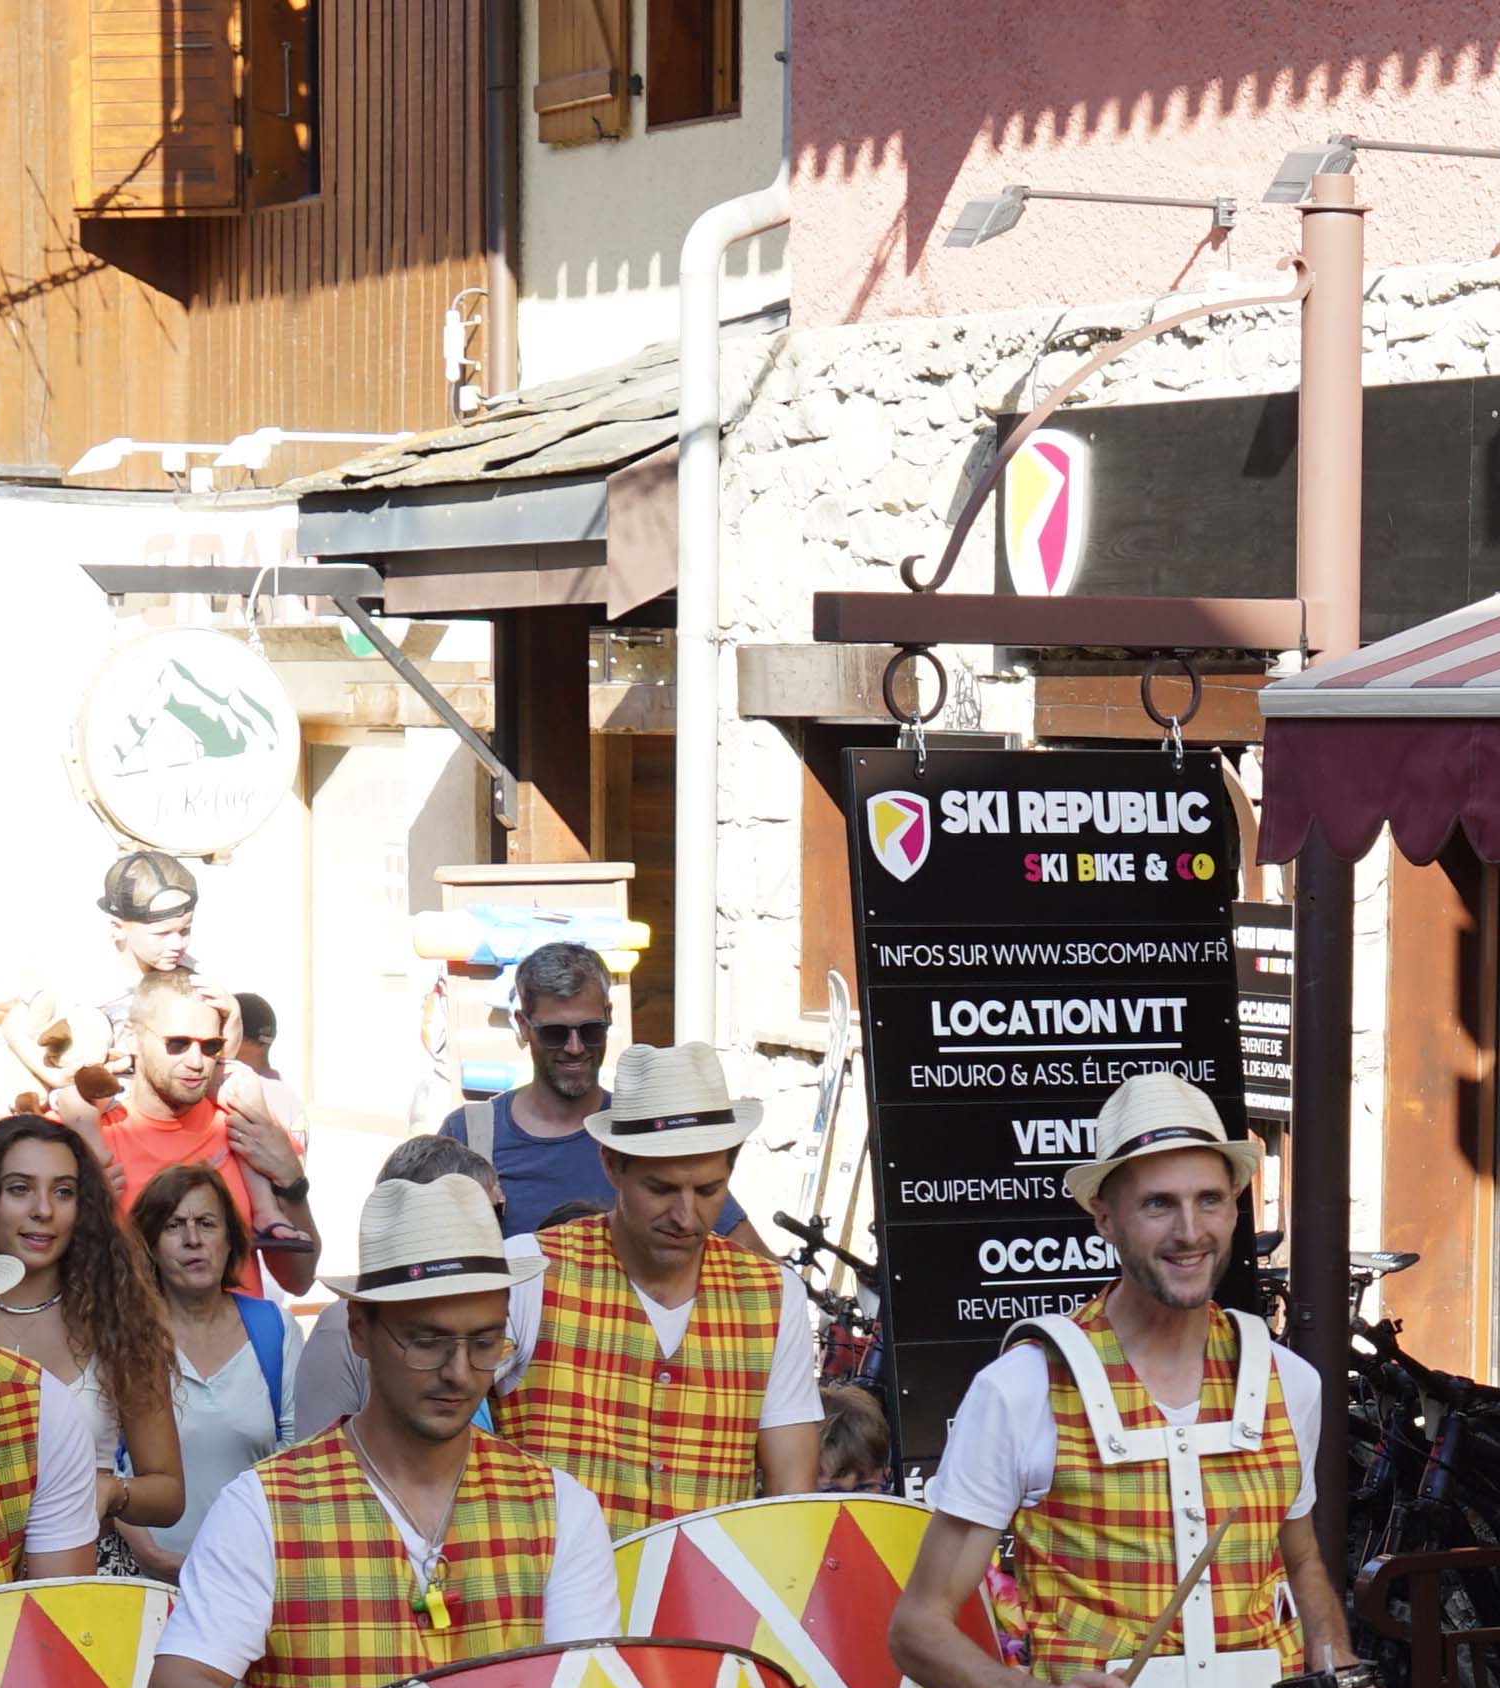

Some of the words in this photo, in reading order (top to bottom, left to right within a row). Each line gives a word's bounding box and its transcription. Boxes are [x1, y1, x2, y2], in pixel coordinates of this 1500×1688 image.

[940, 790, 1010, 836] SKI
[1020, 790, 1212, 836] REPUBLIC
[1025, 855, 1069, 883] SKI
[1078, 854, 1136, 883] BIKE
[1145, 856, 1169, 883] &
[879, 943, 946, 968] INFOS
[949, 943, 989, 967] SUR
[991, 940, 1229, 966] WWW.SBCOMPANY.FR
[931, 999, 1118, 1038] LOCATION
[1122, 998, 1188, 1035] VTT
[910, 1063, 1006, 1089] ENDURO
[1011, 1062, 1029, 1087] &
[1032, 1062, 1079, 1086] ASS.
[1011, 1118, 1099, 1155] VENT
[901, 1176, 1057, 1204] EQUIPEMENTS
[978, 1235, 1122, 1275] OCCASI
[957, 1296, 1053, 1321] REVENTE
[1059, 1293, 1085, 1316] DE
